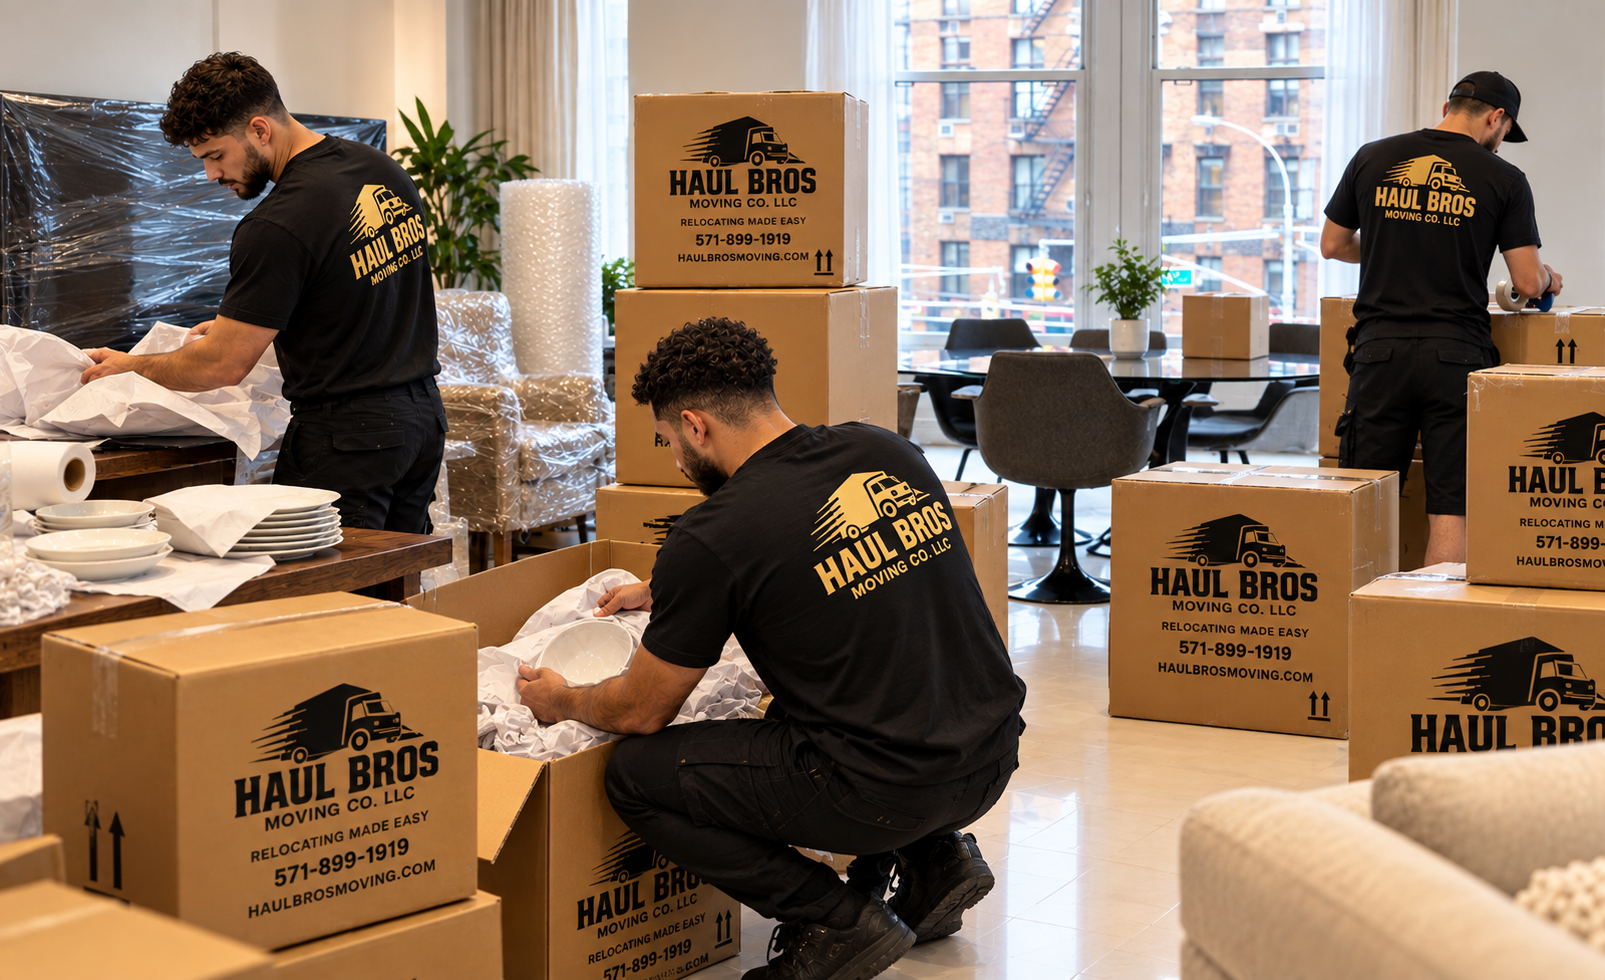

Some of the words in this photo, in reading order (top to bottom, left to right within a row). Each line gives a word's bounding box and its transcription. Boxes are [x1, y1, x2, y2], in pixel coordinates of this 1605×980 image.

[669, 169, 738, 196] HAUL
[747, 167, 816, 195] BROS
[689, 198, 742, 209] MOVING
[746, 198, 770, 208] CO.
[774, 197, 797, 208] LLC
[1374, 186, 1422, 210] HAUL
[1426, 190, 1477, 218] BROS
[680, 217, 744, 227] RELOCATING
[747, 217, 777, 226] MADE
[780, 216, 807, 226] EASY
[1384, 209, 1422, 221] MOVING
[1424, 214, 1440, 224] CO.
[1443, 216, 1461, 227] LLC
[349, 234, 394, 280] HAUL
[390, 214, 425, 254] BROS
[695, 233, 791, 246] 571-899-1919
[398, 254, 411, 268] CO.
[410, 245, 423, 260] LLC
[677, 252, 809, 263] HAULBROSMOVING.COM
[1508, 465, 1584, 494] HAUL
[1529, 497, 1587, 509] MOVING
[1519, 518, 1591, 529] RELOCATING
[813, 531, 899, 596] HAUL
[891, 501, 953, 551] BROS
[1516, 556, 1605, 569] HAULBROSMO
[850, 560, 909, 600] MOVING
[909, 549, 933, 567] CO.
[930, 537, 952, 556] LLC
[1150, 567, 1229, 599] HAUL
[1239, 570, 1318, 602] BROS
[1172, 600, 1232, 613] MOVING
[1238, 603, 1264, 615] CO.
[1270, 605, 1297, 616] LLC
[1161, 621, 1236, 634] RELOCATING
[1240, 626, 1275, 636] MADE
[1278, 628, 1309, 638] EASY
[1179, 640, 1292, 661] 571-899-1919
[1158, 662, 1313, 683] HAULBROSMOVING.COM
[1410, 714, 1517, 753] HAUL
[234, 762, 335, 818] HAUL
[348, 740, 439, 794] BROS
[264, 803, 340, 832] MOVING
[347, 795, 378, 812] CO.
[384, 786, 415, 805] LLC
[251, 831, 344, 863] RELOCATING
[349, 819, 390, 839] MADE
[394, 810, 429, 829] EASY
[274, 837, 409, 887] 571-899-1919
[248, 859, 436, 919] HAULBROSMOVING.COM
[576, 880, 645, 931] HAUL
[654, 866, 709, 903] BRO
[597, 911, 649, 939] MOVING
[652, 903, 673, 919] CO.
[677, 893, 698, 910] LLC
[588, 933, 651, 965] RELOCATING
[653, 922, 681, 941] MADE
[682, 912, 706, 930] EASY
[603, 938, 691, 980] 571-899-1919
